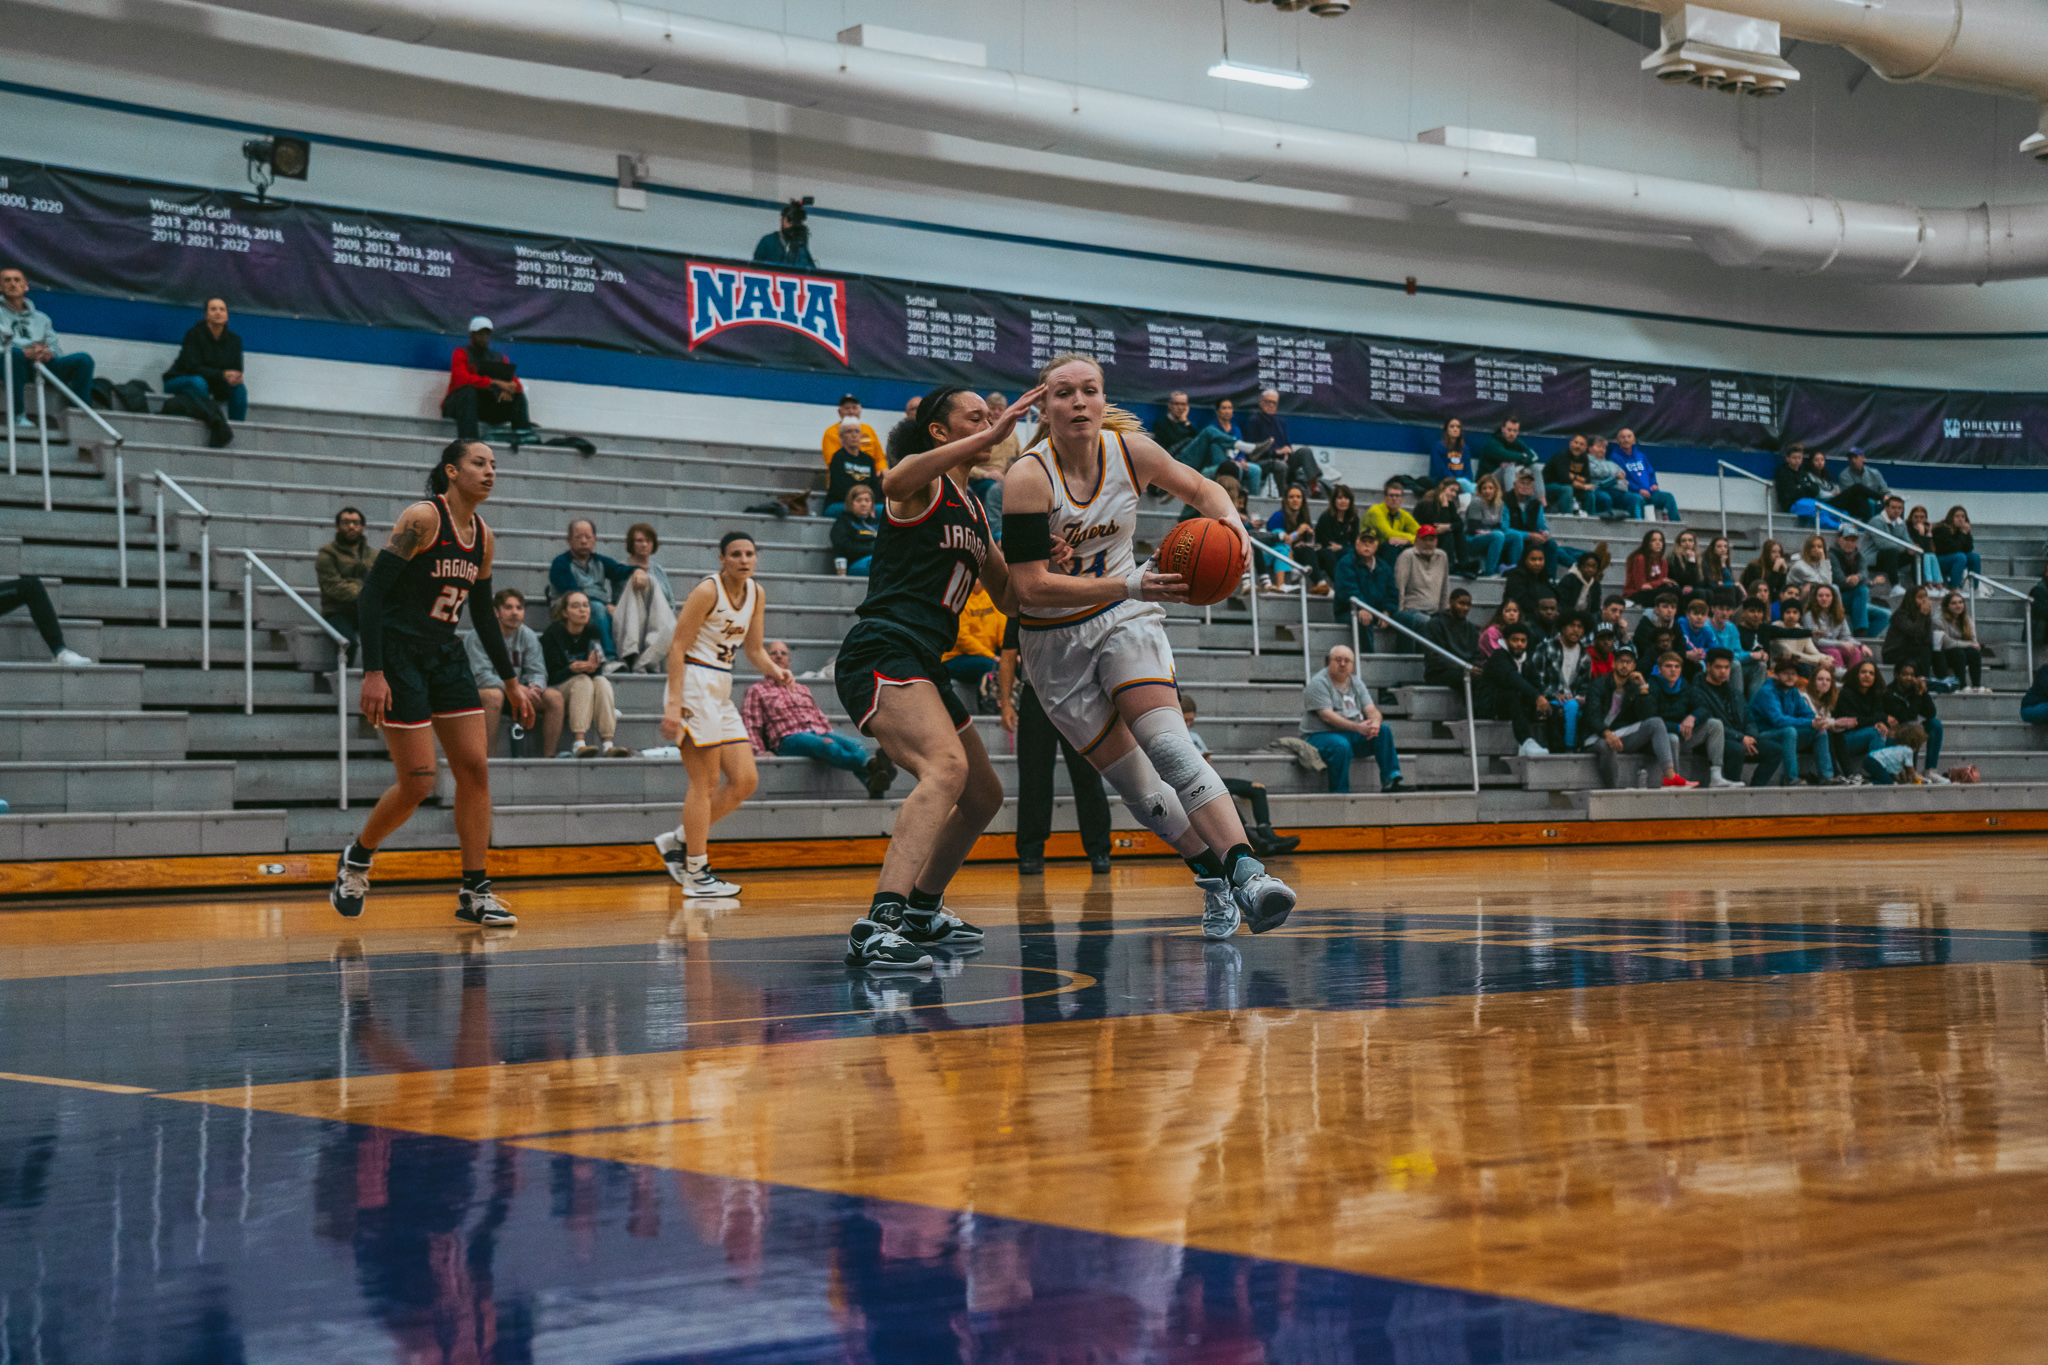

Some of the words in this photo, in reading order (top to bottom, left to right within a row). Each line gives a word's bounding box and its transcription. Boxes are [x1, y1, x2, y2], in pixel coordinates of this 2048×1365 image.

[31, 197, 64, 214] 2020
[149, 198, 204, 217] Women's
[206, 206, 231, 219] Golf
[151, 213, 184, 230] 2013,
[187, 219, 218, 235] 2014,
[220, 223, 252, 239] 2016,
[253, 227, 284, 243] 2018,
[151, 228, 184, 246] 2019,
[221, 238, 250, 252] 2022
[332, 222, 364, 237] Men's
[365, 226, 401, 241] Soccer
[333, 237, 363, 252] 2009,
[365, 241, 394, 256] 2012,
[396, 244, 425, 260] 2013,
[426, 248, 454, 264] 2014,
[513, 246, 560, 262] Women's
[561, 250, 594, 265] Soccer
[333, 251, 363, 266] 2016,
[366, 256, 391, 271] 2017,
[426, 263, 451, 277] 2021
[516, 259, 544, 273] 2010,
[545, 264, 571, 277] 2011,
[573, 267, 599, 280] 2012,
[600, 270, 626, 284] 2013,
[516, 274, 543, 288] 2014,
[571, 281, 595, 293] 2020
[689, 265, 846, 358] NAIA
[1963, 420, 2023, 433] OBERWEIS
[1062, 519, 1120, 549] Tigers
[941, 560, 972, 614] 10
